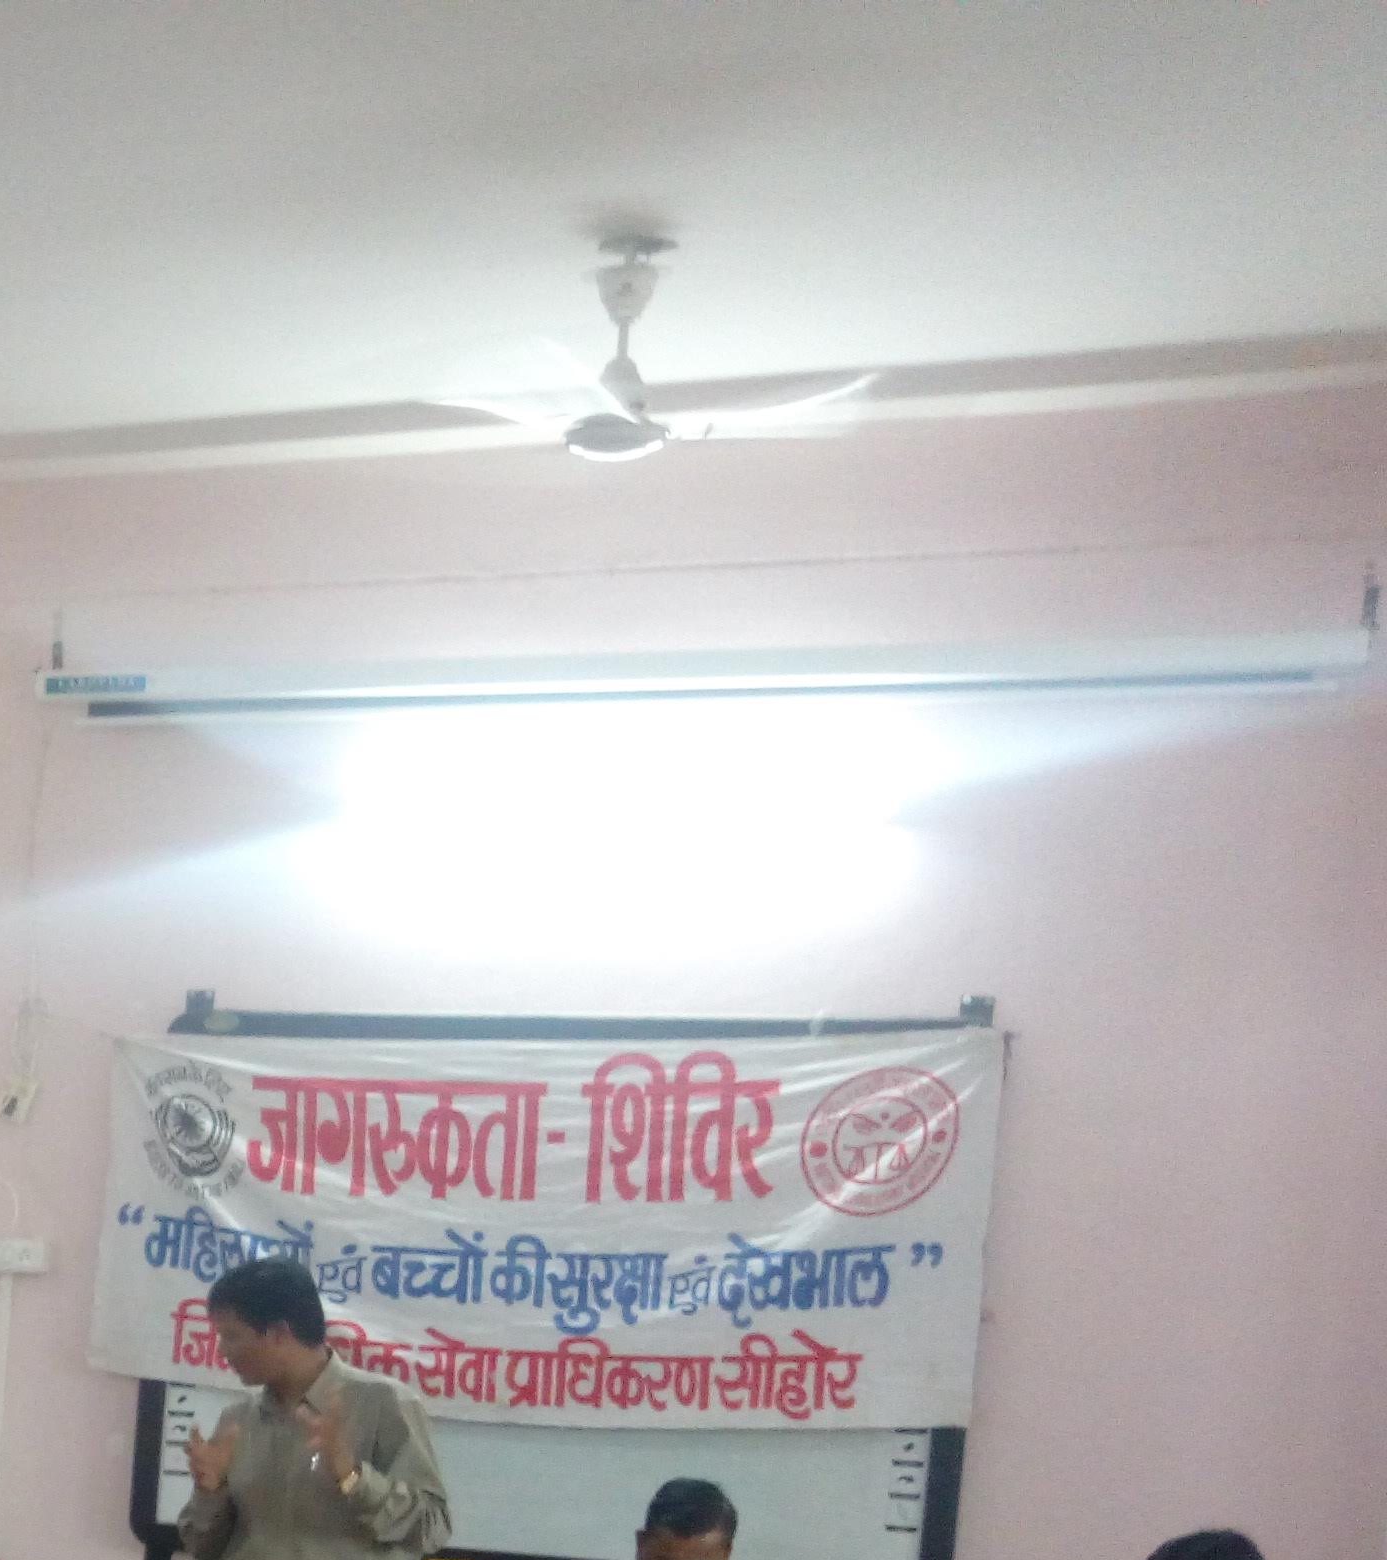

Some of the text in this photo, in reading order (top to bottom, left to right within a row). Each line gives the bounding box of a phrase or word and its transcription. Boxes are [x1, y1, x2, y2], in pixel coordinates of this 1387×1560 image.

[582, 1050, 781, 1203] शिविर
[316, 1244, 367, 1303] एवं
[371, 1228, 487, 1304] बच्चों
[489, 1234, 551, 1308] की
[547, 1251, 668, 1335] सुरक्षा
[667, 1254, 716, 1315] एवं
[414, 1327, 503, 1401] सेवा
[504, 1335, 714, 1411] प्राधिकरण
[714, 1328, 864, 1420] सीहोर
